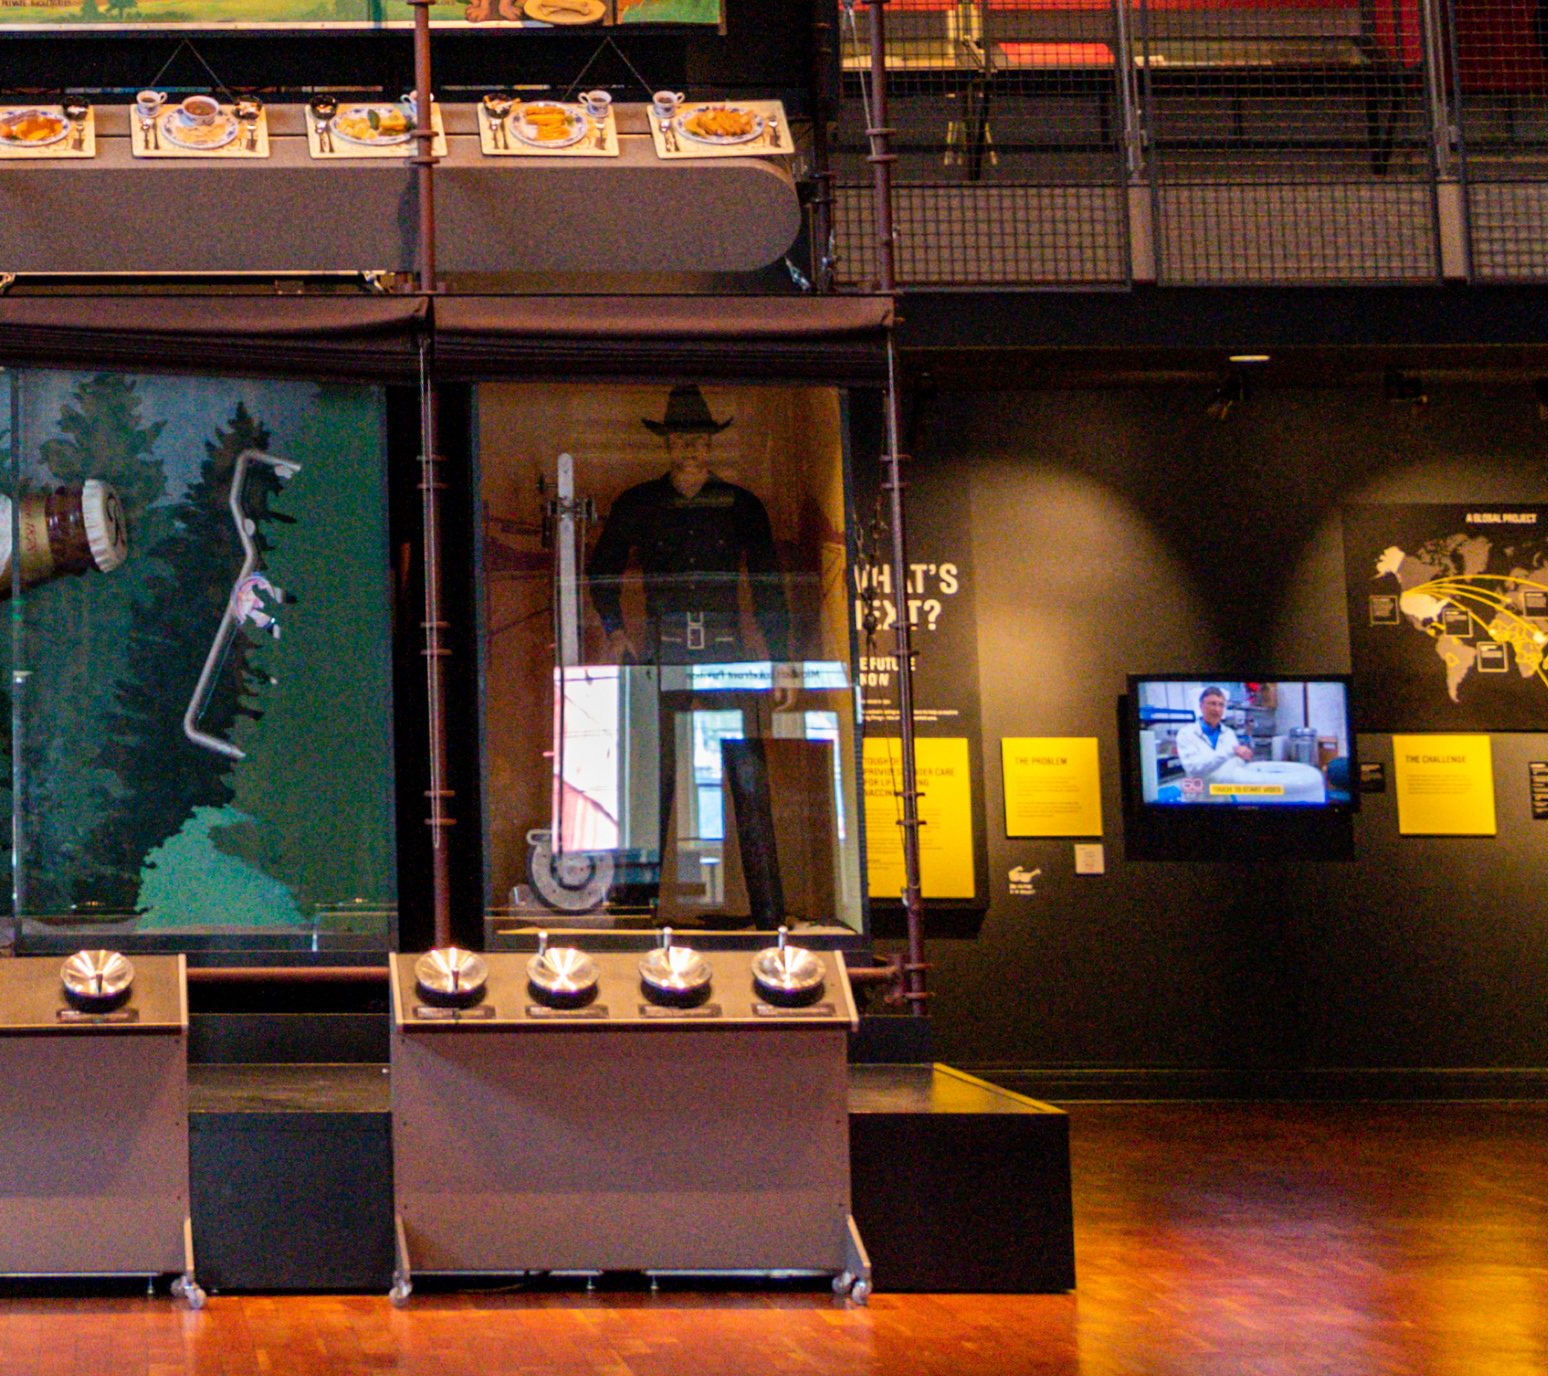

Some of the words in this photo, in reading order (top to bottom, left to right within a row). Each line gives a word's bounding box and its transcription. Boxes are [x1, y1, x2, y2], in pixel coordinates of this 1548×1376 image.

[1503, 513, 1537, 523] PROJECT
[1015, 757, 1028, 765] THE
[1032, 757, 1067, 765] PROBLEM
[1406, 755, 1420, 763] THE
[1423, 755, 1466, 763] CHALLENGE
[936, 768, 954, 776] CARE
